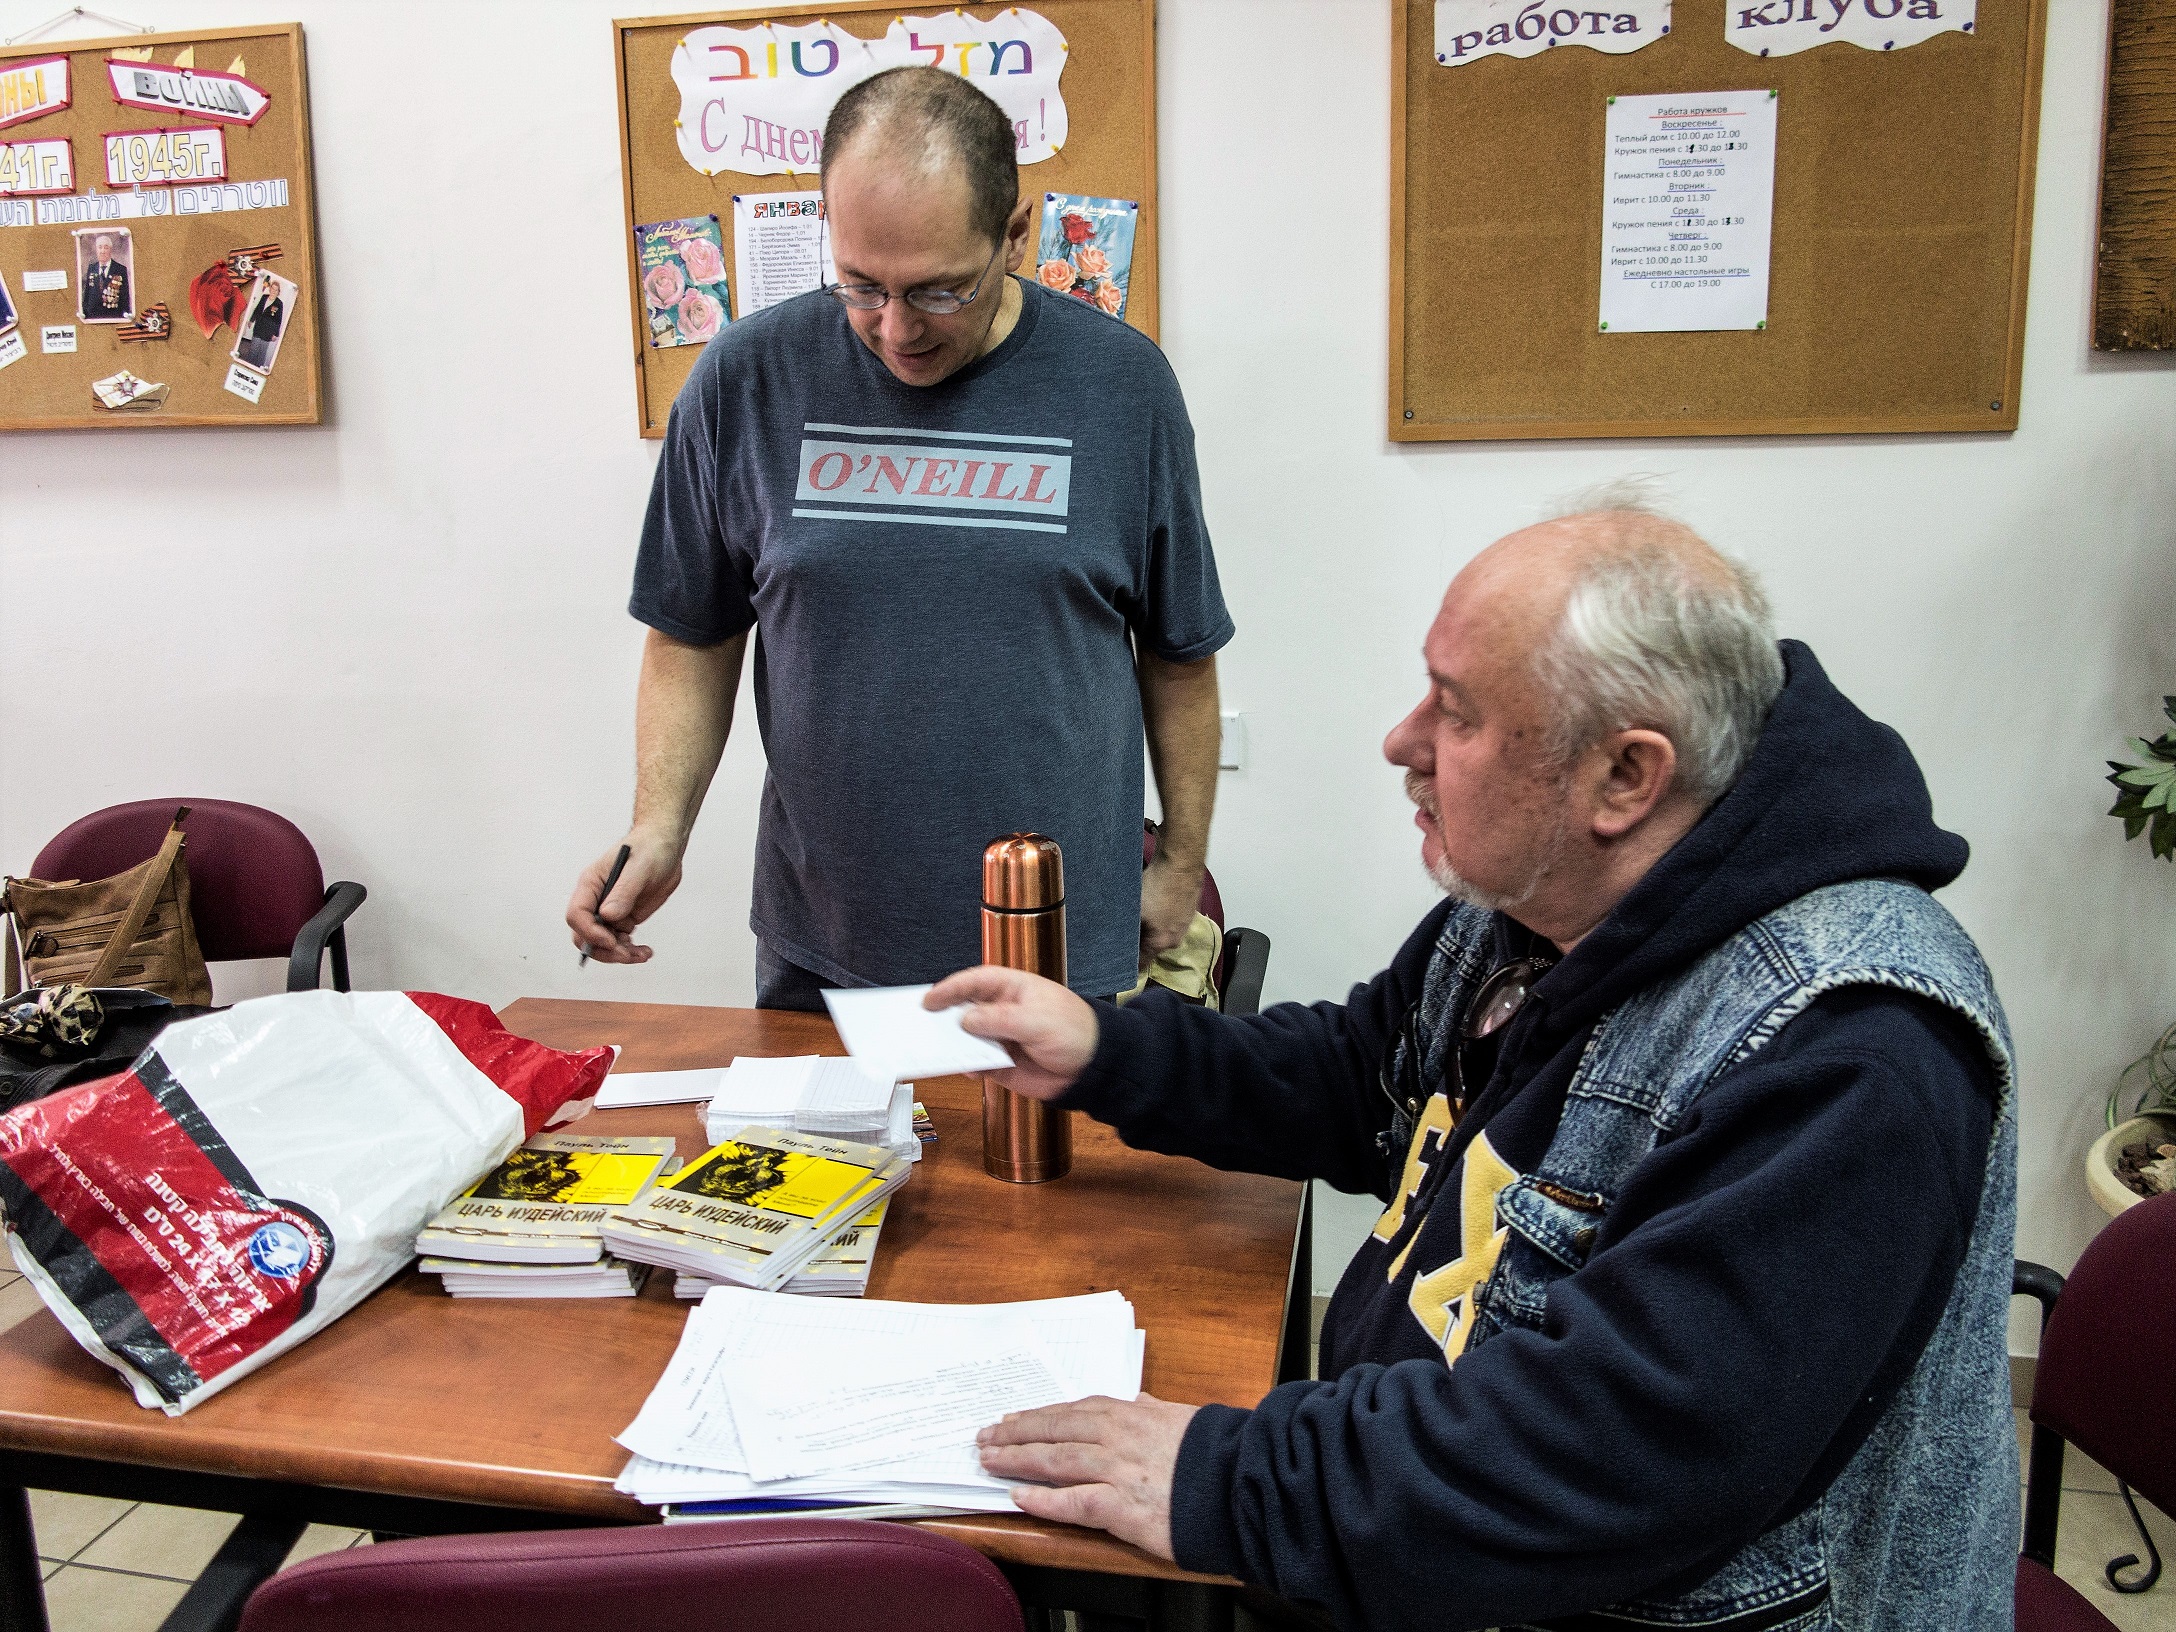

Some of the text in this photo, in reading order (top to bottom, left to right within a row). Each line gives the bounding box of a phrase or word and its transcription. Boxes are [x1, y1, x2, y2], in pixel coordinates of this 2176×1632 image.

[1451, 0, 1641, 57] работа
[709, 33, 1033, 82] מזל טוב
[1658, 106, 1728, 116] Работа кружков
[1615, 134, 1648, 143] Теплый
[1677, 132, 1700, 140] 10.00
[1702, 132, 1714, 140] до
[1717, 130, 1740, 138] 12.00
[110, 134, 221, 182] 1945г.
[1615, 148, 1647, 156] Кружок
[0, 145, 70, 190] 41г.
[1658, 158, 1718, 167] Понедельник
[1614, 172, 1663, 180] Гимнастика
[1673, 170, 1691, 178] 8.00
[1693, 170, 1704, 178] до
[1707, 168, 1725, 176] 9.00
[1669, 182, 1705, 190] Вторник
[42, 188, 120, 223] מלחמת
[134, 184, 168, 216] של
[1613, 197, 1639, 205] Иврит
[1648, 195, 1671, 203] 10.00
[1673, 195, 1684, 203] до
[1688, 194, 1710, 202] 11.30
[754, 200, 825, 220] январ
[1672, 207, 1699, 216] Среда
[1613, 222, 1644, 230] Кружок
[1612, 245, 1661, 253] Гимнастика
[1670, 244, 1688, 252] 8.00
[1690, 244, 1701, 252] до
[1611, 258, 1637, 266] Иврит
[1670, 257, 1682, 265] до
[1624, 270, 1672, 278] Ежедневно
[1728, 267, 1749, 275] игры
[1698, 279, 1721, 288] 19.00
[808, 451, 1057, 504] O'NEILL
[145, 1171, 187, 1216] קטנה
[458, 1203, 607, 1223] ЦАРЬ ИУДЕЙСКИЙ
[649, 1195, 789, 1235] ЦАРЬ ИУДЕЙСКИЙ
[169, 1233, 191, 1256] 24
[186, 1253, 202, 1269] X
